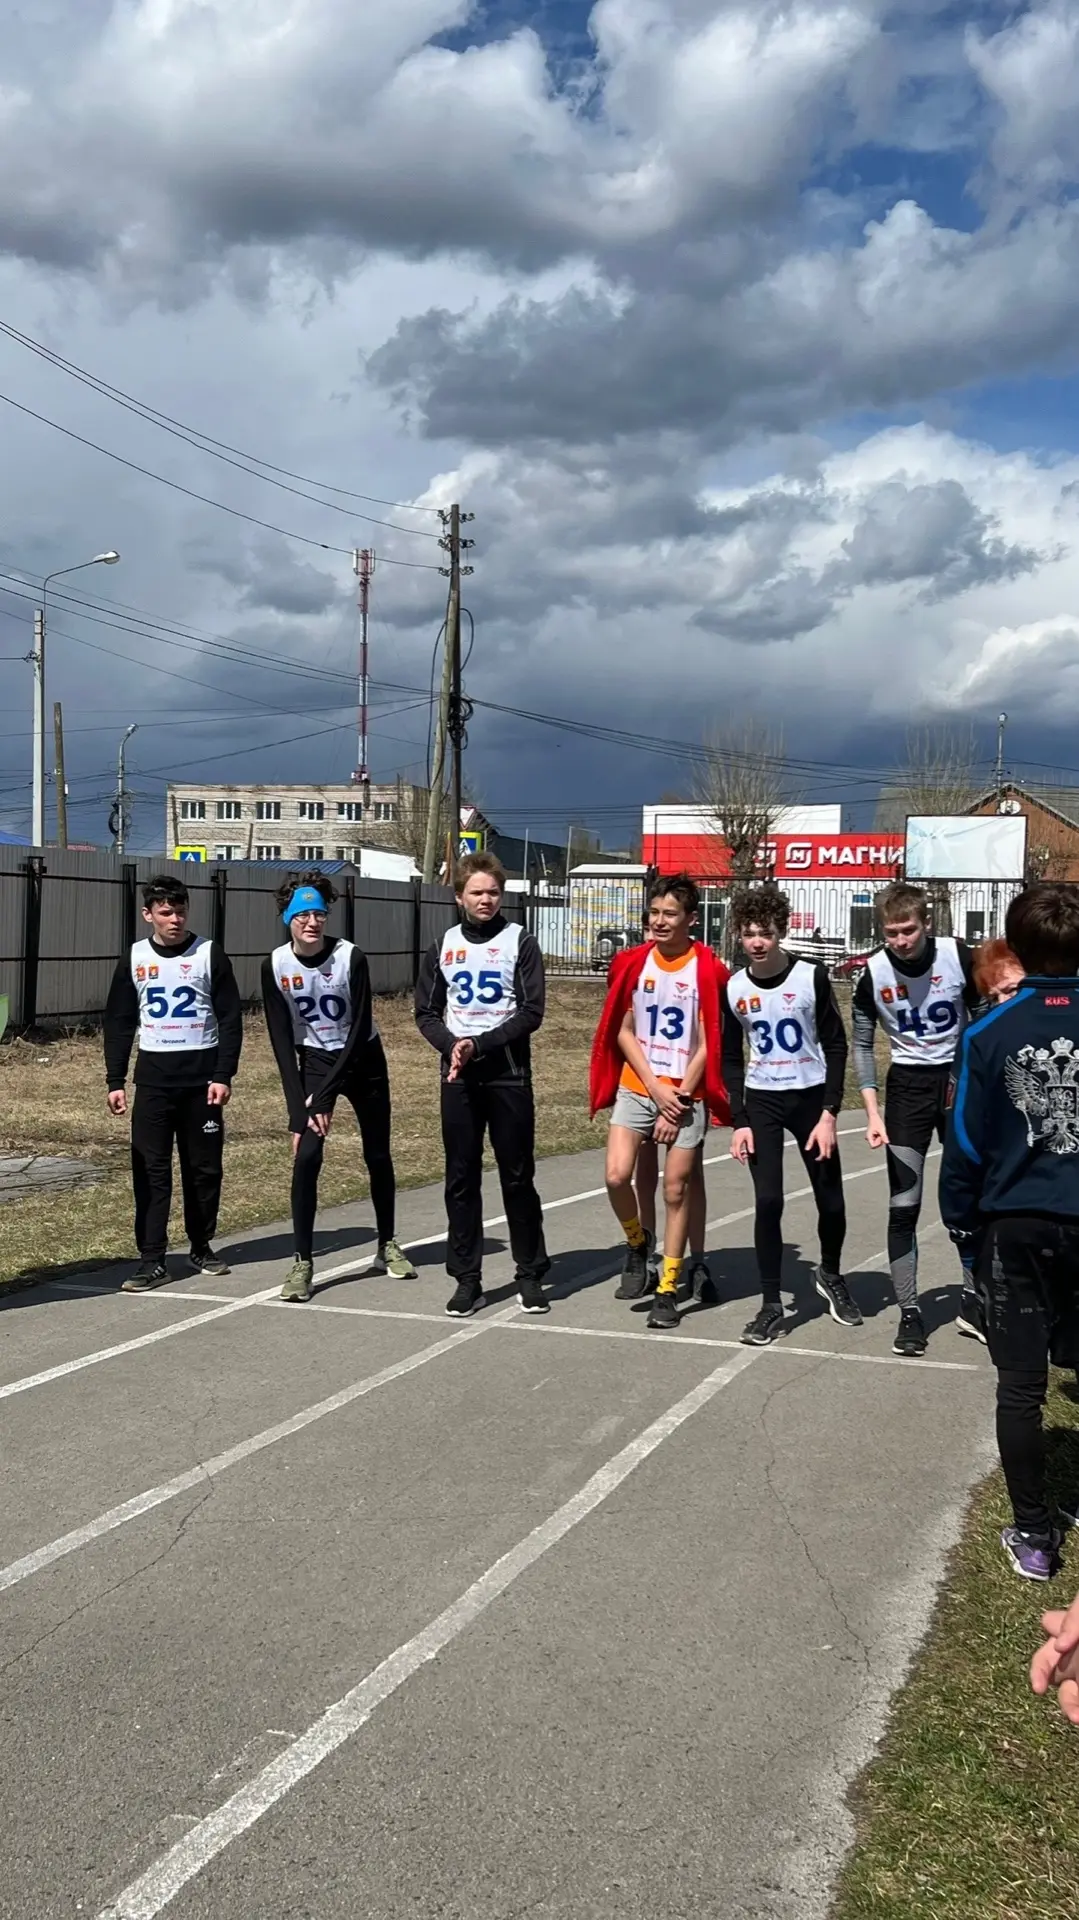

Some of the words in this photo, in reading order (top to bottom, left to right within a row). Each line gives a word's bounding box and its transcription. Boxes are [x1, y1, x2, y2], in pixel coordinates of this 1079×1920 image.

[818, 846, 905, 865] МАГНИ
[146, 985, 198, 1019] 52
[451, 970, 503, 1005] 35
[1044, 996, 1070, 1005] RUS
[294, 994, 346, 1023] 20
[645, 1004, 685, 1040] 13
[897, 1000, 958, 1037] 49
[752, 1017, 803, 1055] 30
